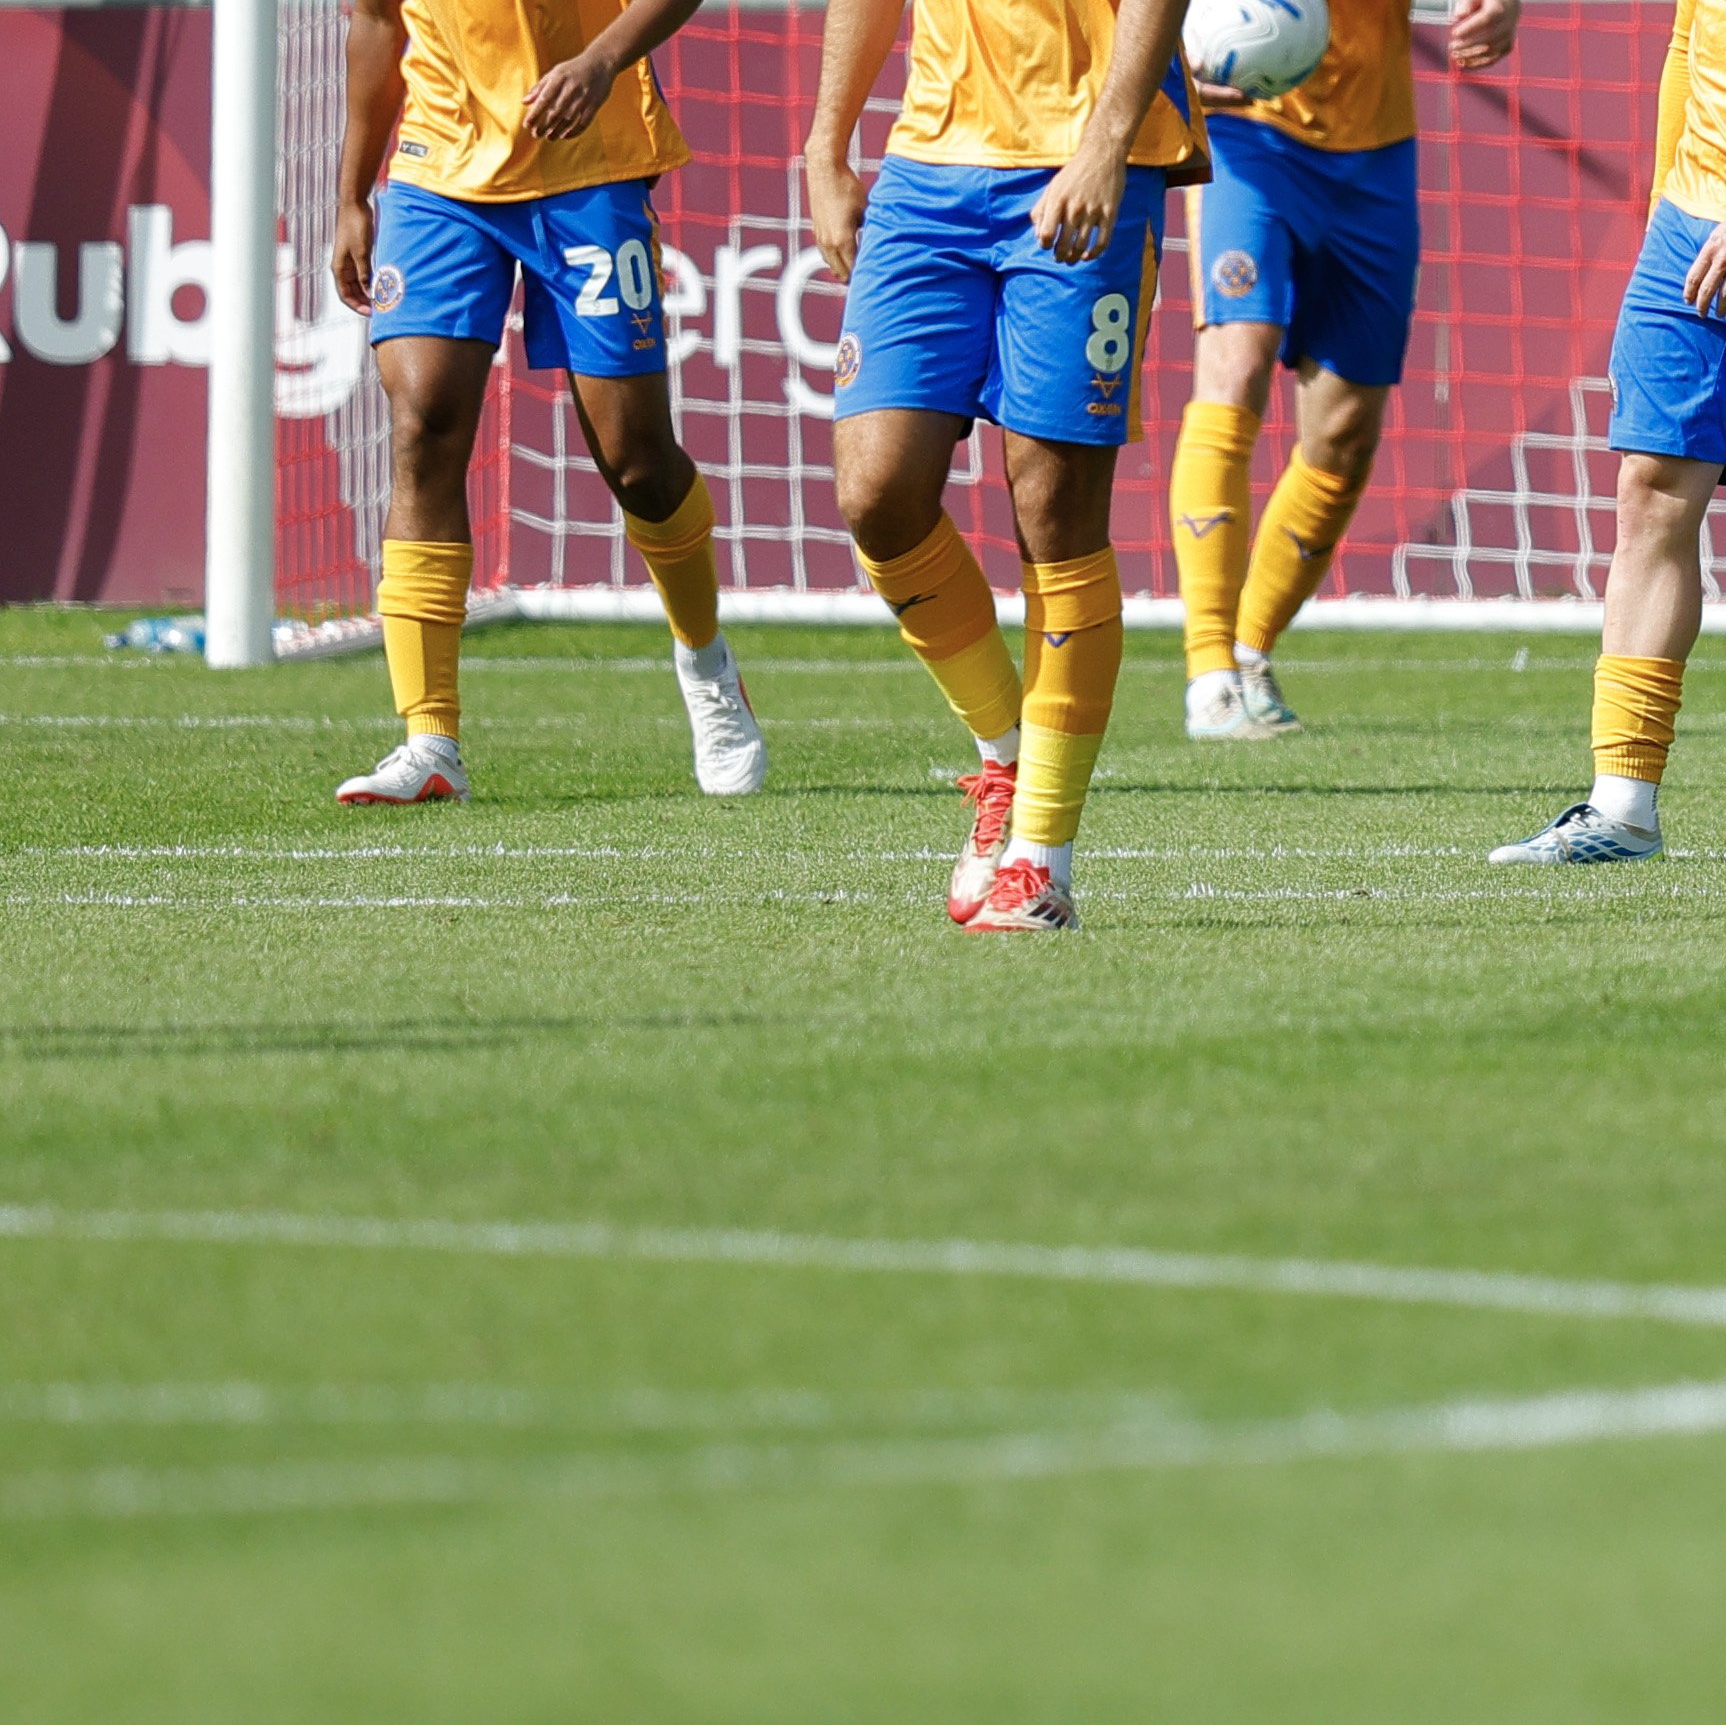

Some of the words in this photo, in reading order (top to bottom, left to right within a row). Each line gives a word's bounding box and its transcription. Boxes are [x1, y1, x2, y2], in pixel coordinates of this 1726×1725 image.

[0, 203, 366, 418] uby
[563, 238, 652, 317] 20
[1085, 293, 1130, 373] 8
